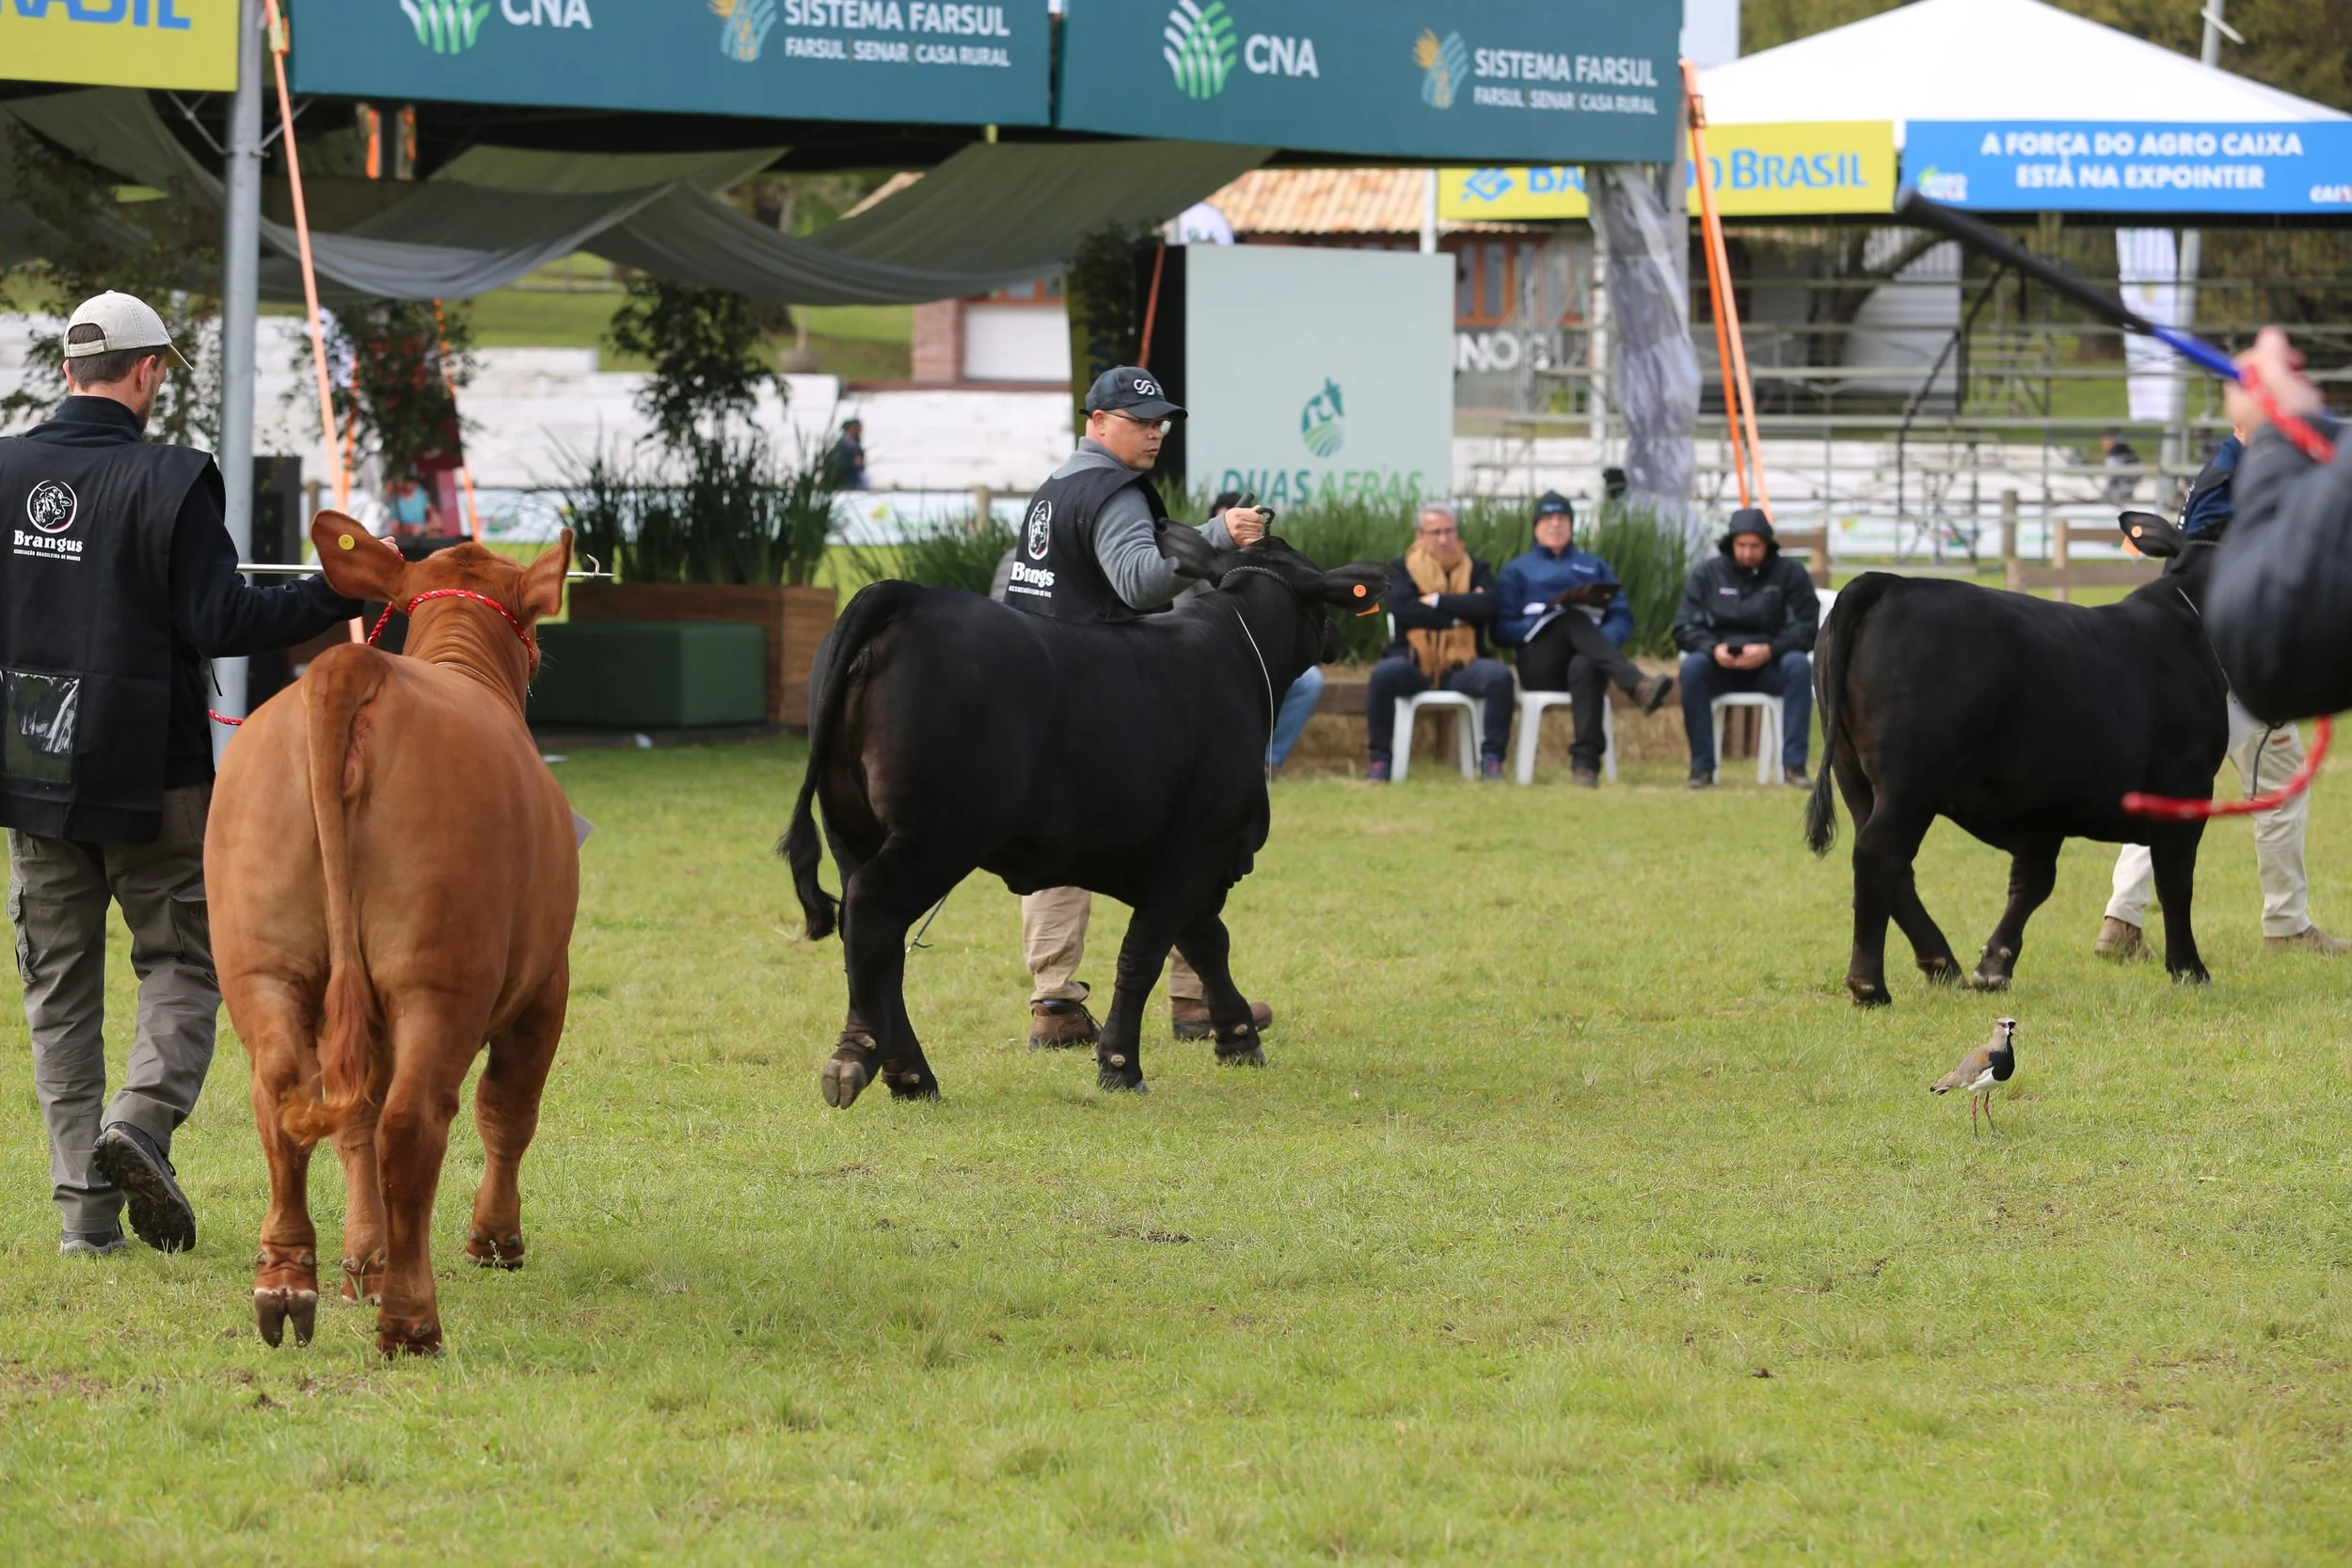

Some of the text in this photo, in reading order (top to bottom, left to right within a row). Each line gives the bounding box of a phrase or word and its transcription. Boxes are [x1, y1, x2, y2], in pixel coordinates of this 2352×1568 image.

[500, 0, 594, 29] CNA
[785, 0, 1011, 37] SISTEMA FARSUL
[785, 36, 1012, 67] FARSUL SENAR CASA RURAL
[1244, 33, 1319, 78] CNA
[1473, 48, 1659, 87] SISTEMA FARSUL
[1473, 86, 1659, 115] FARSUL SENAR CASA RURAL
[1980, 132, 2303, 163] A FORÇA DO AGRO CAIXA
[1731, 149, 1867, 190] BRASIL
[2016, 158, 2265, 190] ESTÁ NA EXPOINTER
[13, 530, 83, 553] Brangus
